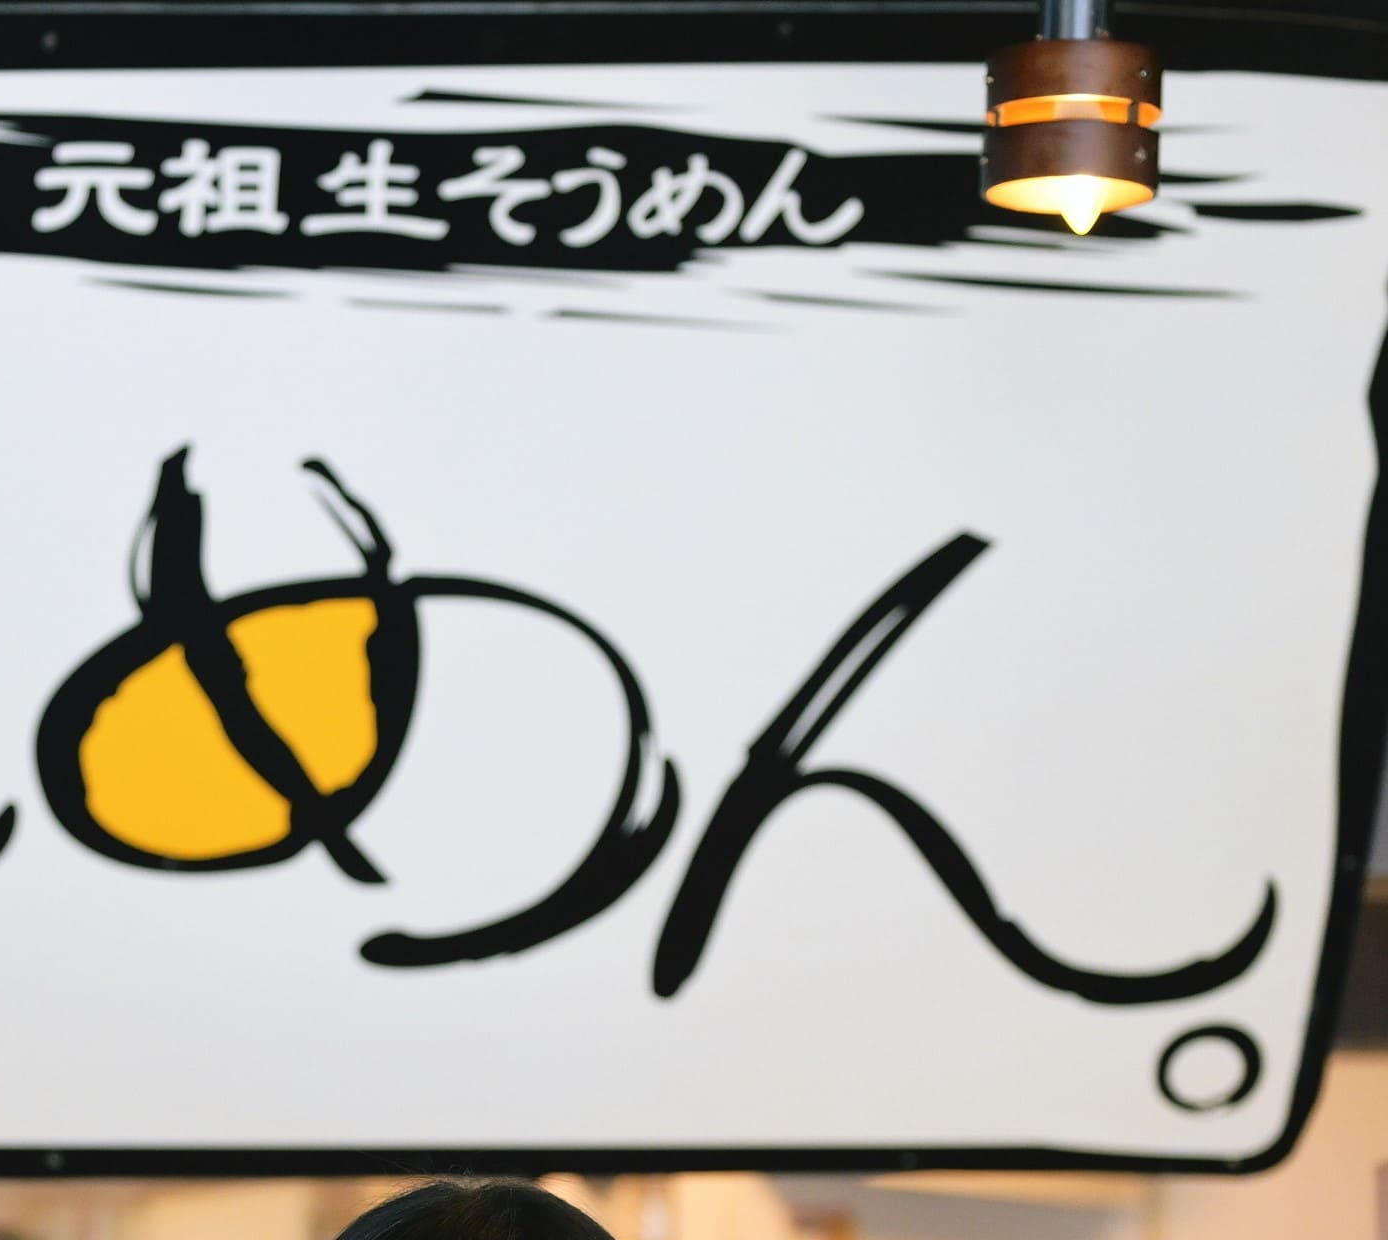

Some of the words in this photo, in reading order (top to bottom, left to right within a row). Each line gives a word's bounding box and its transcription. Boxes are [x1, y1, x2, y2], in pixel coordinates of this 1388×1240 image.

[32, 138, 865, 248] 元祖生そうめん
